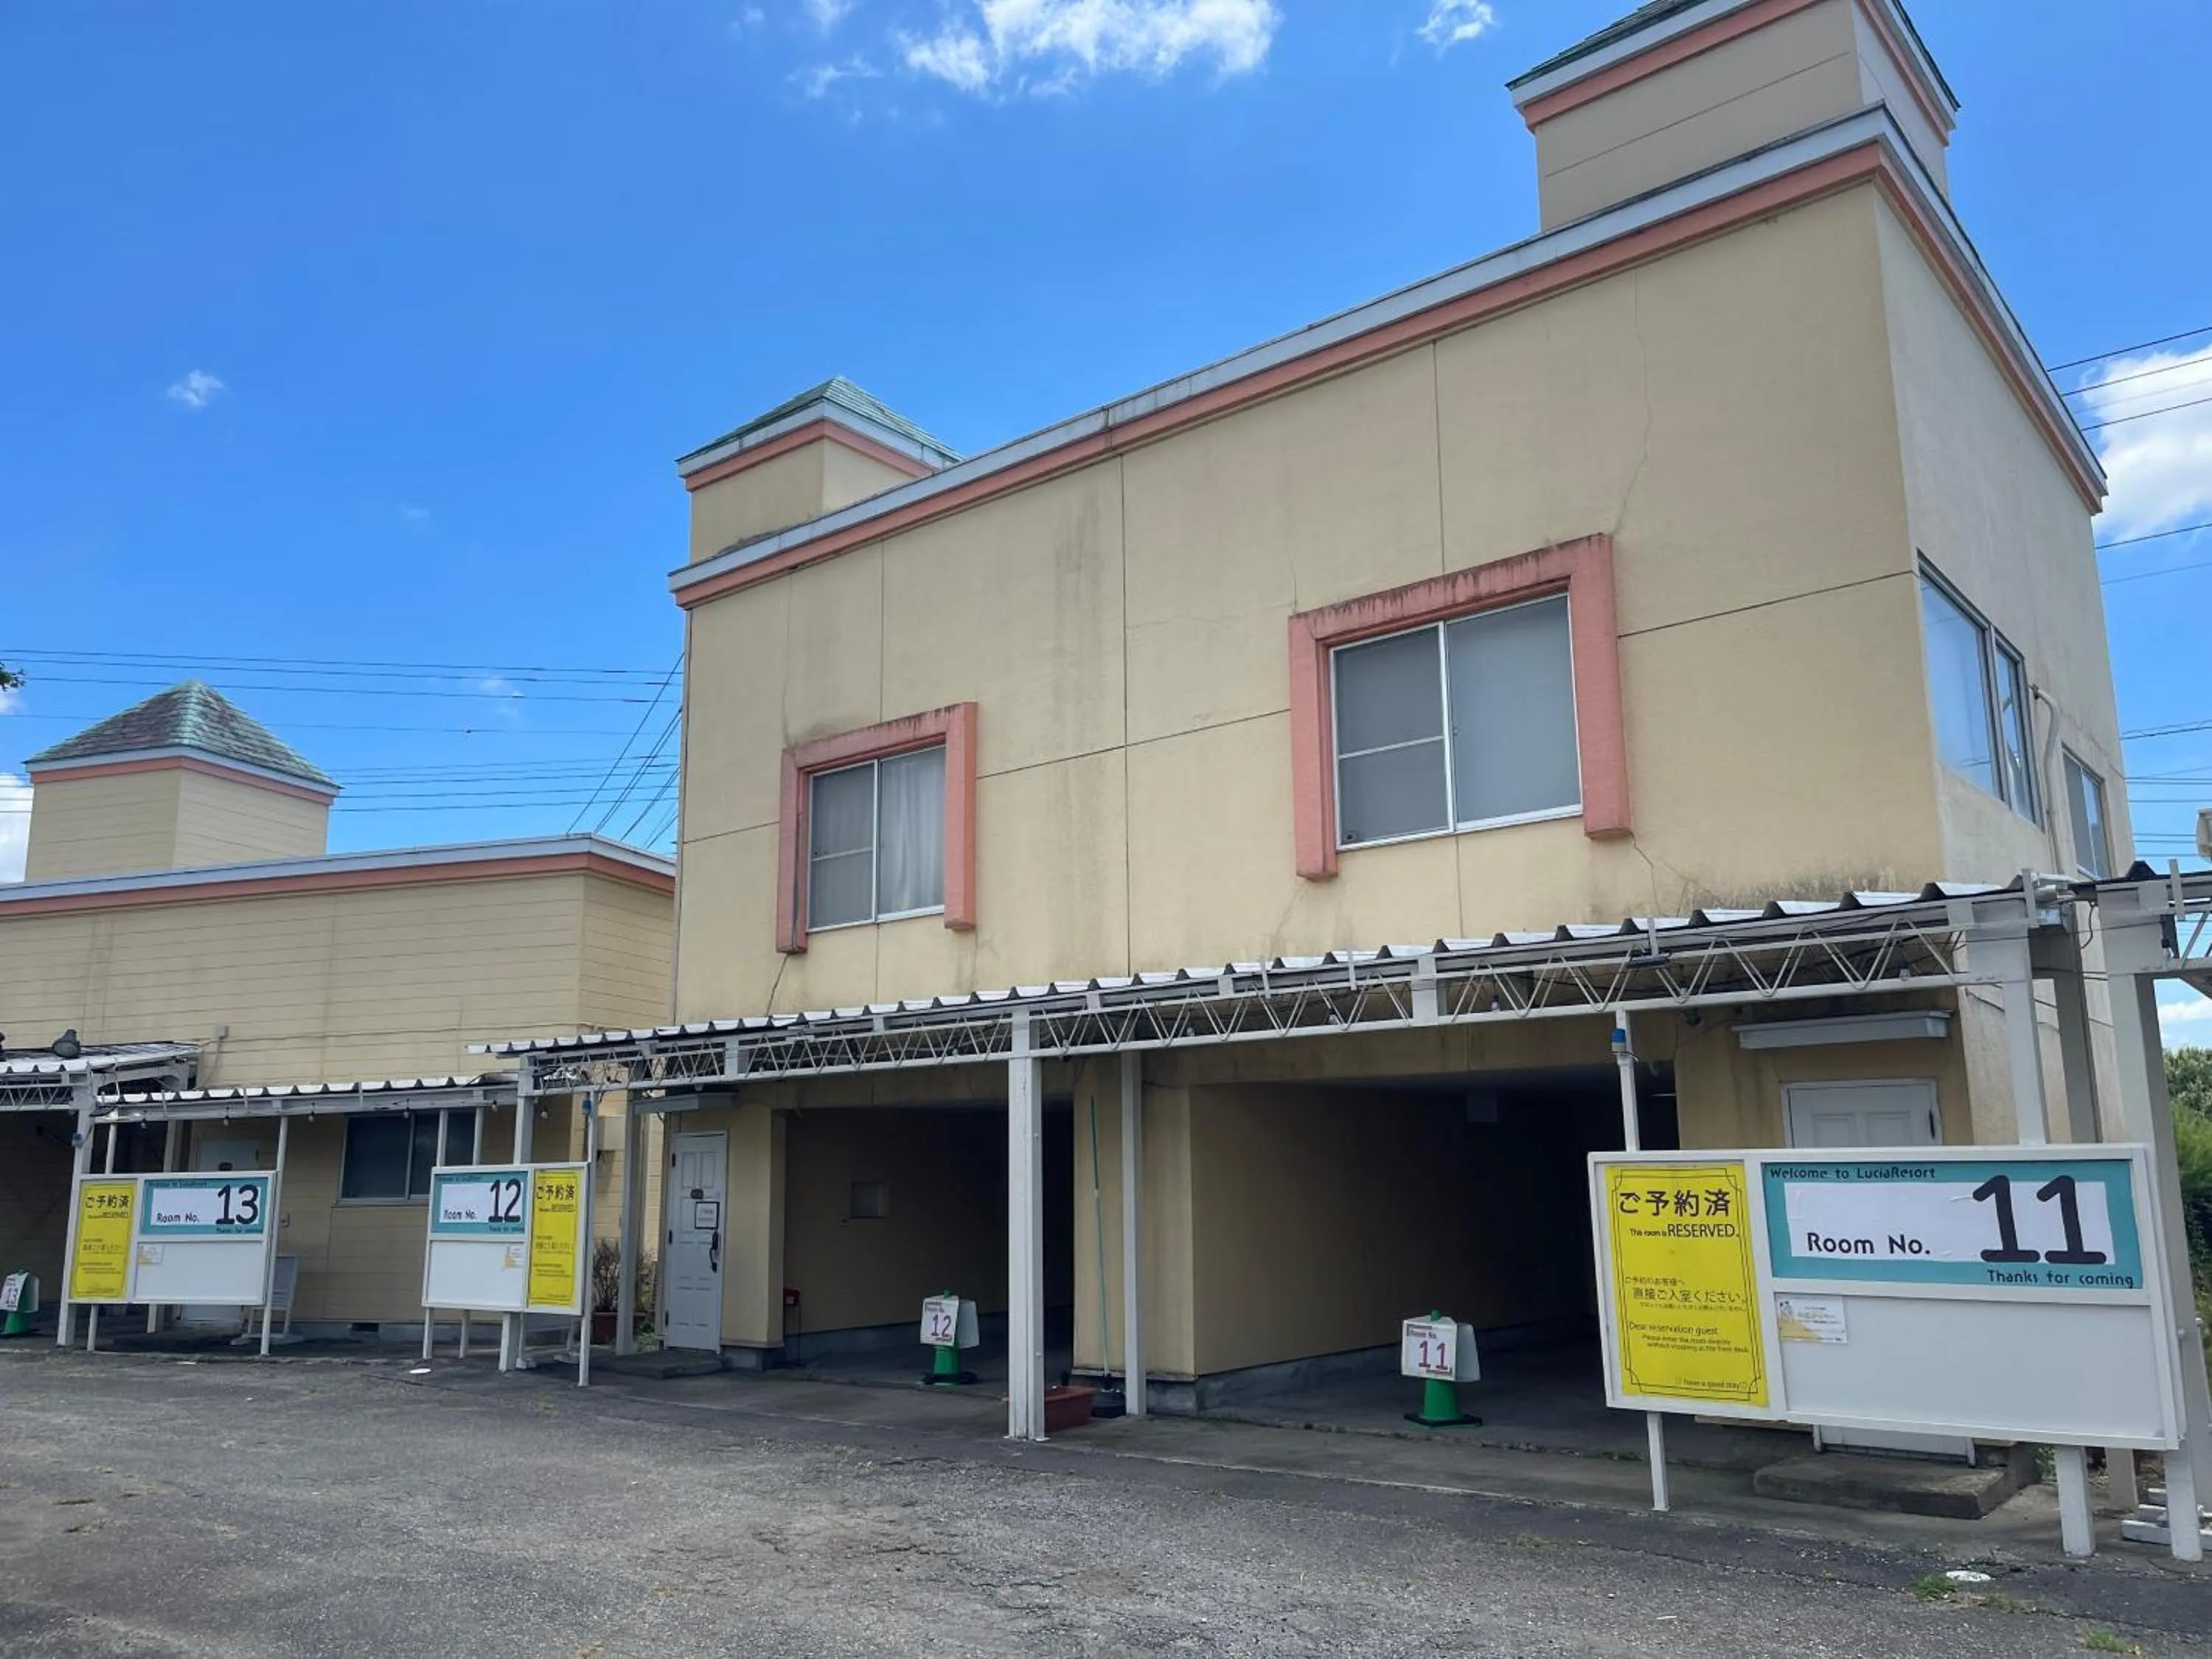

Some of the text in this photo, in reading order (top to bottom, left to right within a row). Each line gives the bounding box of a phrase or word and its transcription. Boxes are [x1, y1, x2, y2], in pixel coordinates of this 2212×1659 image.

[1770, 1166, 1935, 1178] Welcome to LuciaResort
[86, 1194, 130, 1208] ご予約済
[216, 1184, 259, 1224] 13
[488, 1179, 521, 1222] 12
[536, 1185, 575, 1200] ご予約済
[1619, 1189, 1731, 1217] ご予約済
[157, 1212, 200, 1222] Room No.
[1973, 1175, 2107, 1265] 11
[1807, 1232, 1930, 1255] Room No.
[1987, 1270, 2134, 1288] Thanks for coming
[931, 1314, 952, 1337] 12
[1419, 1341, 1448, 1370] 11
